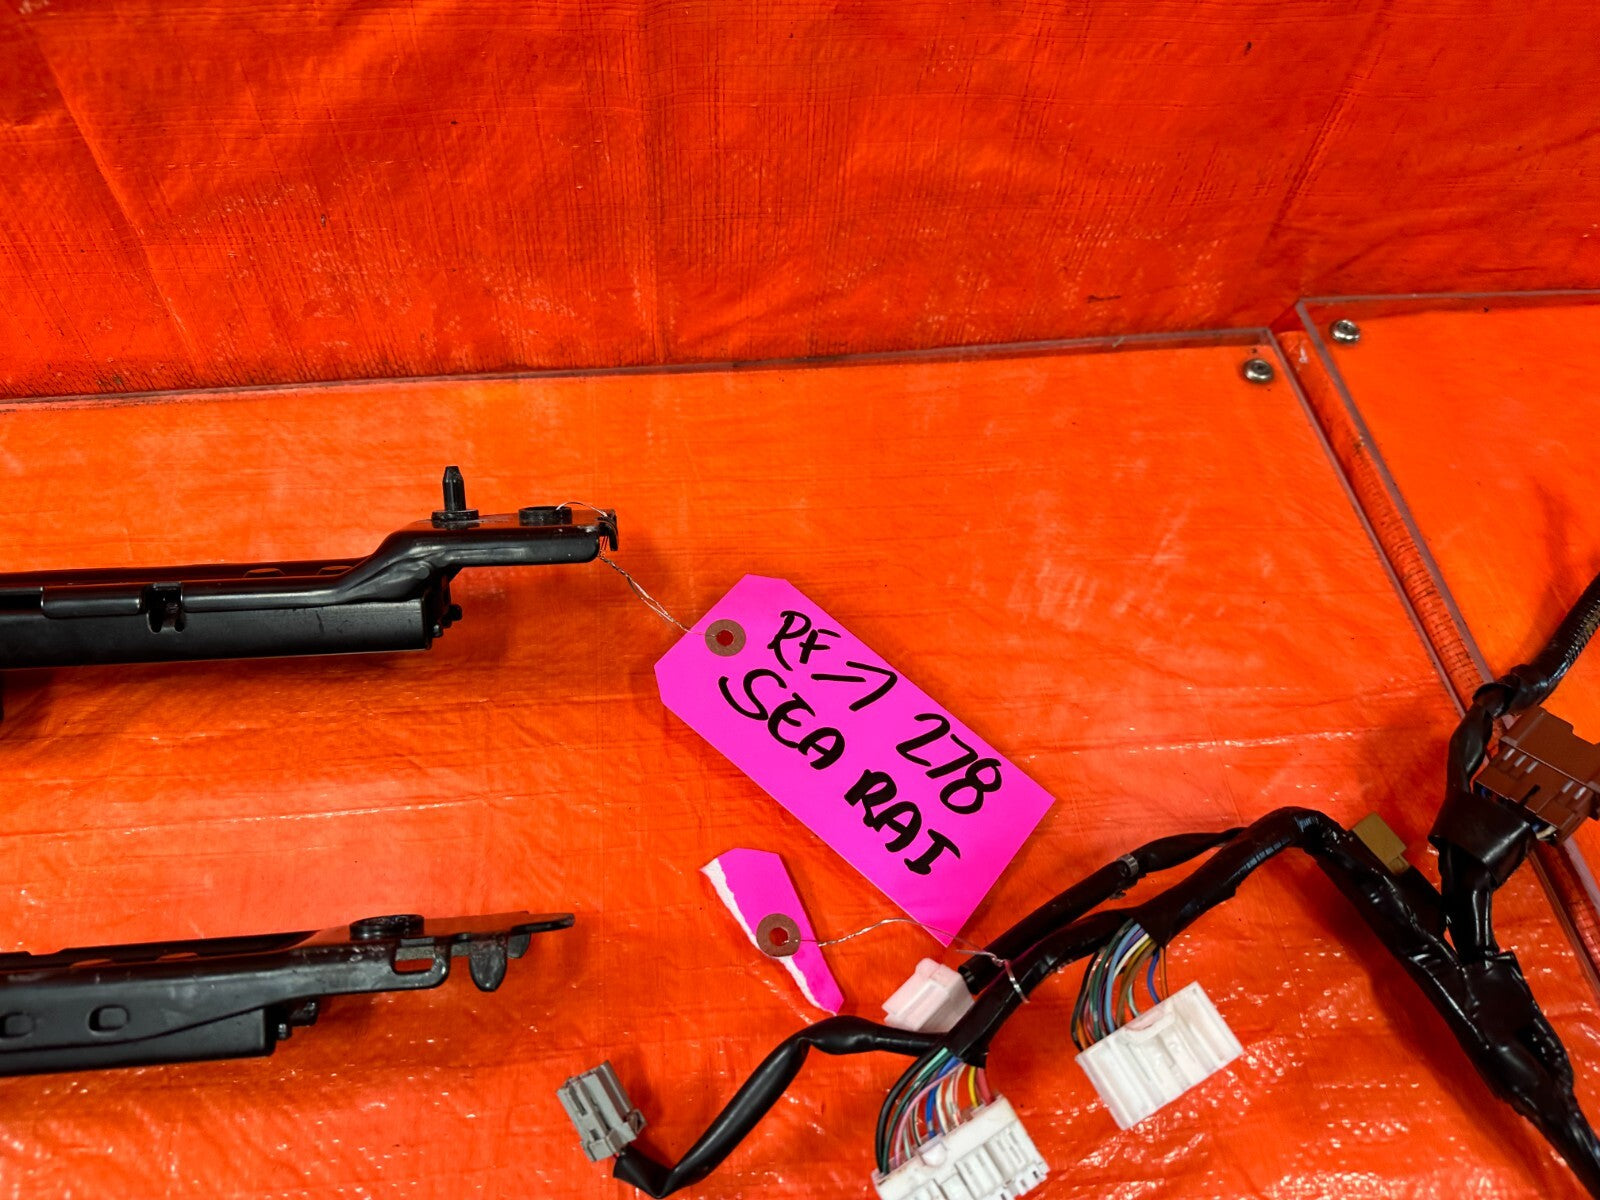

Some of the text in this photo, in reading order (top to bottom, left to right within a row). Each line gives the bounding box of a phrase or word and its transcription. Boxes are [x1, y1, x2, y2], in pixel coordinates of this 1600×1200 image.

[718, 668, 961, 875] SEA RAI
[895, 713, 1003, 815] 278
